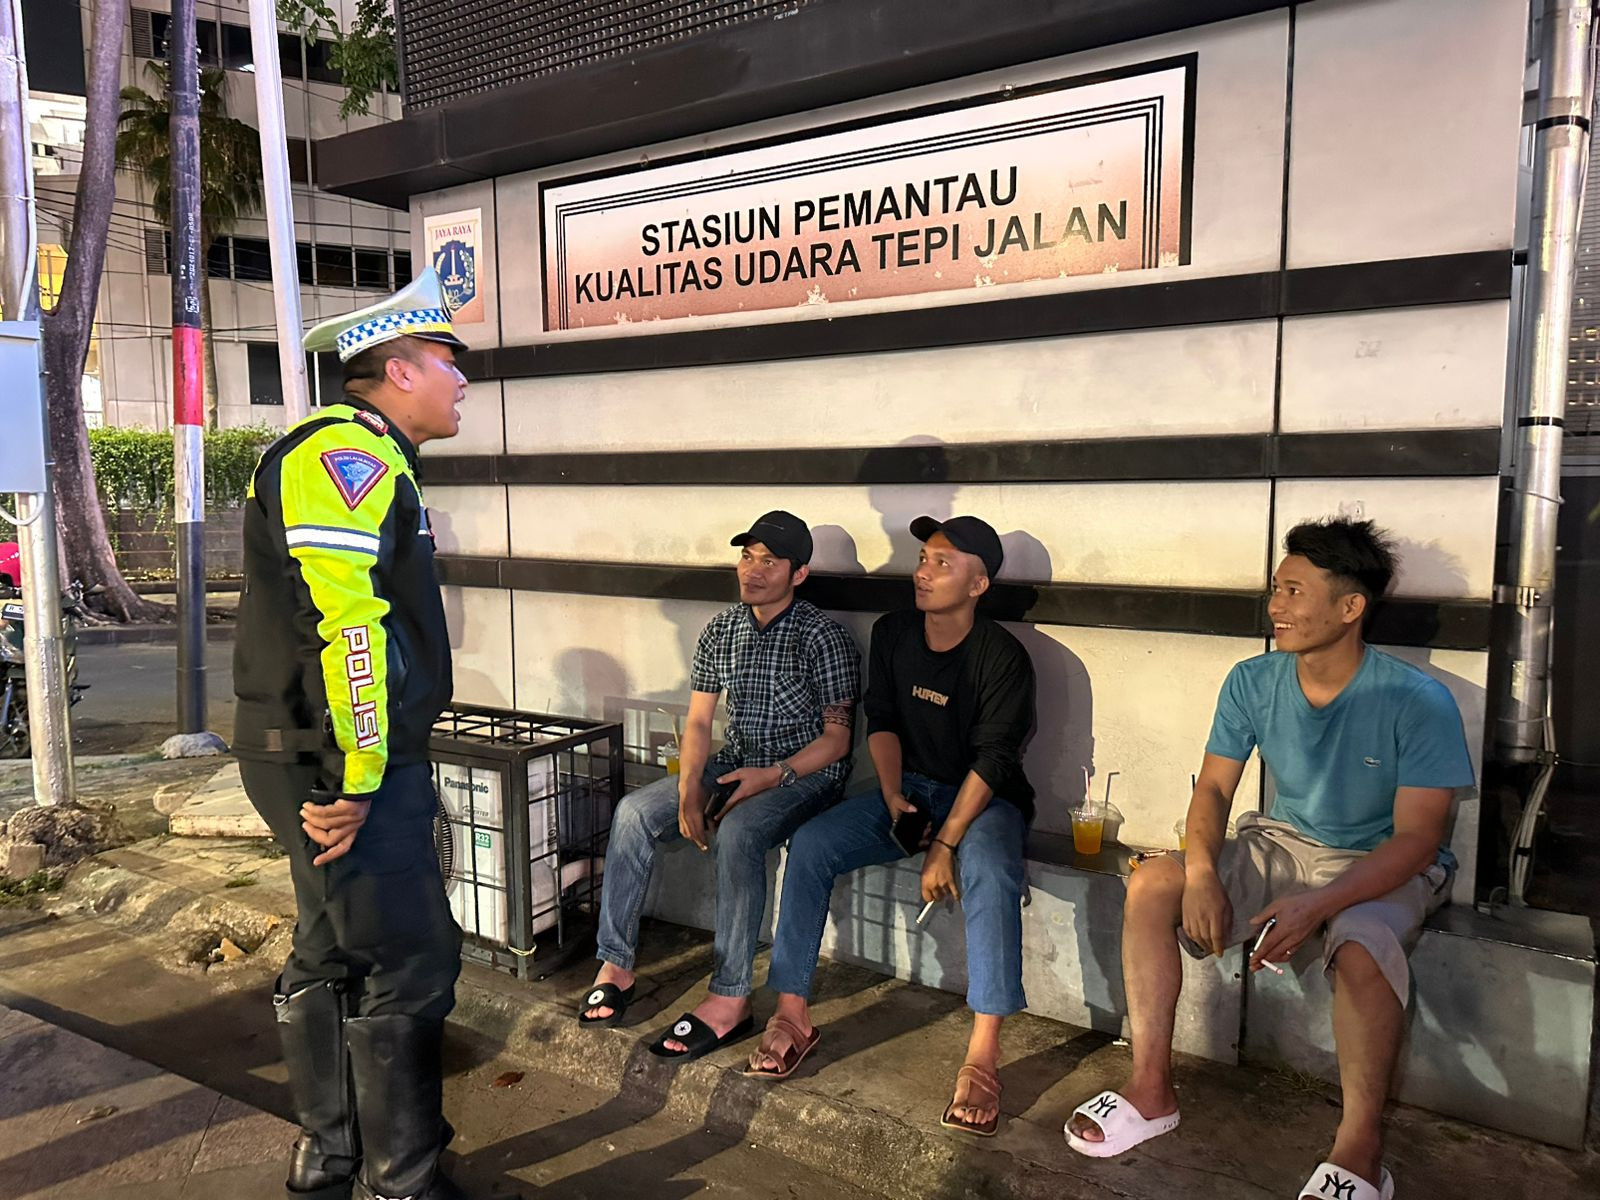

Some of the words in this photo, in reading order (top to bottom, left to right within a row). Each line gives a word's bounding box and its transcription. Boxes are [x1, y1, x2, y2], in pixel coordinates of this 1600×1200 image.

[435, 229, 452, 241] JAYA
[452, 224, 472, 236] RAYA
[641, 204, 780, 257] STASIUN
[794, 165, 1017, 236] PEMANTAU
[575, 256, 723, 304] KUALITAS
[734, 238, 862, 287] UDARA
[871, 223, 960, 270] TEPI
[973, 200, 1127, 258] JALAN
[341, 625, 381, 749] POLISI
[475, 832, 490, 843] R32
[1088, 1094, 1118, 1118] NY
